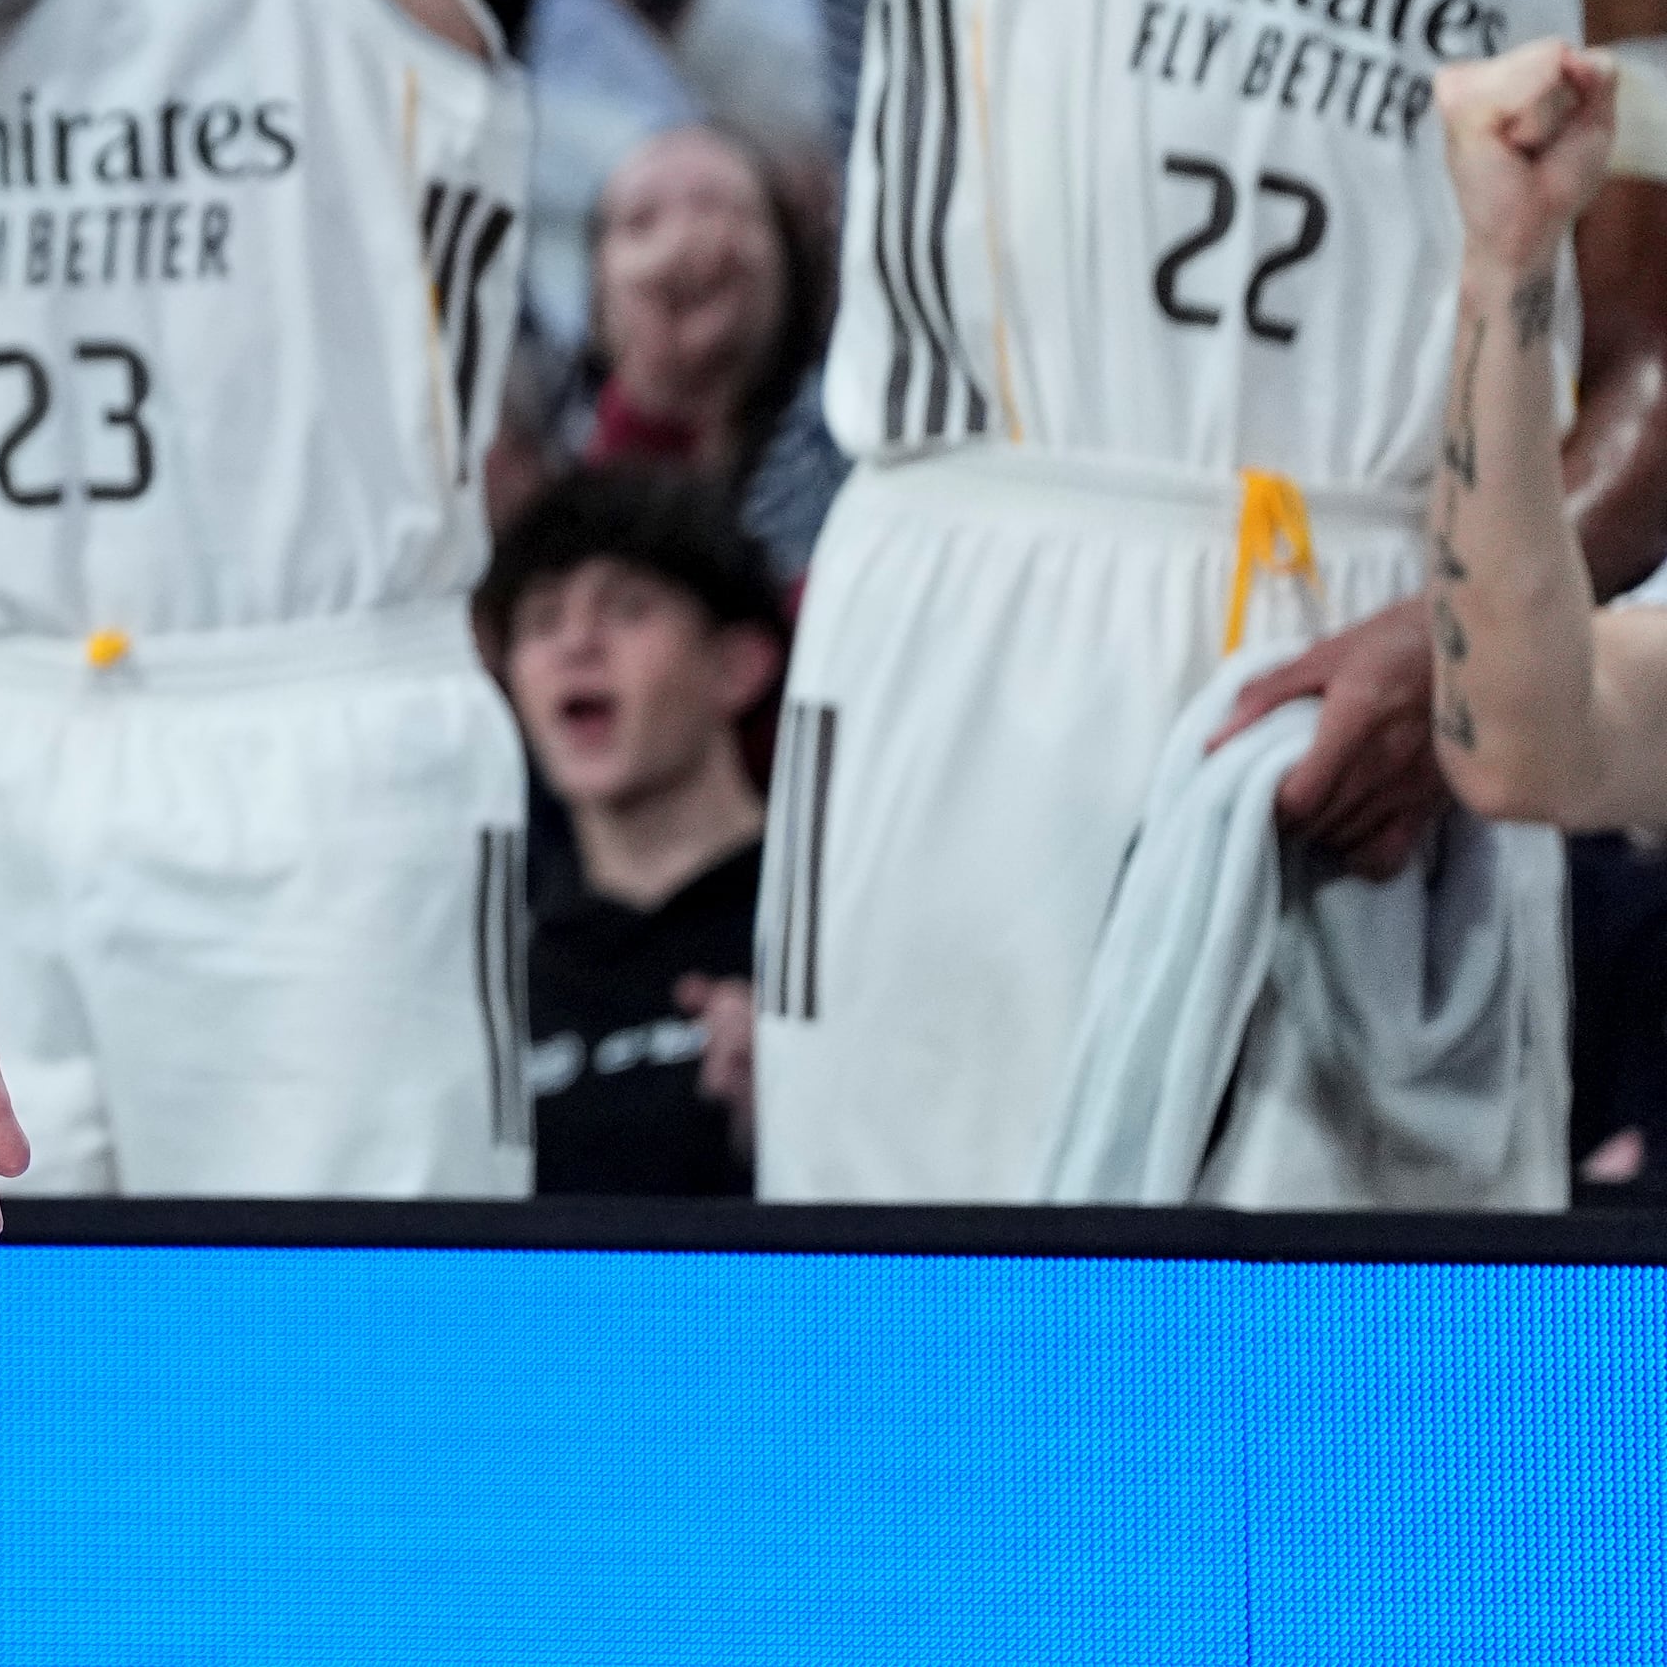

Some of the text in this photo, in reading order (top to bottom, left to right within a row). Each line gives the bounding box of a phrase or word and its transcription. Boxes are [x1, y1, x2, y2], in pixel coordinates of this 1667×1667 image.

[1129, 0, 1435, 148] FLY BETTER
[24, 199, 233, 288] BETTER
[1151, 153, 1330, 345] 22
